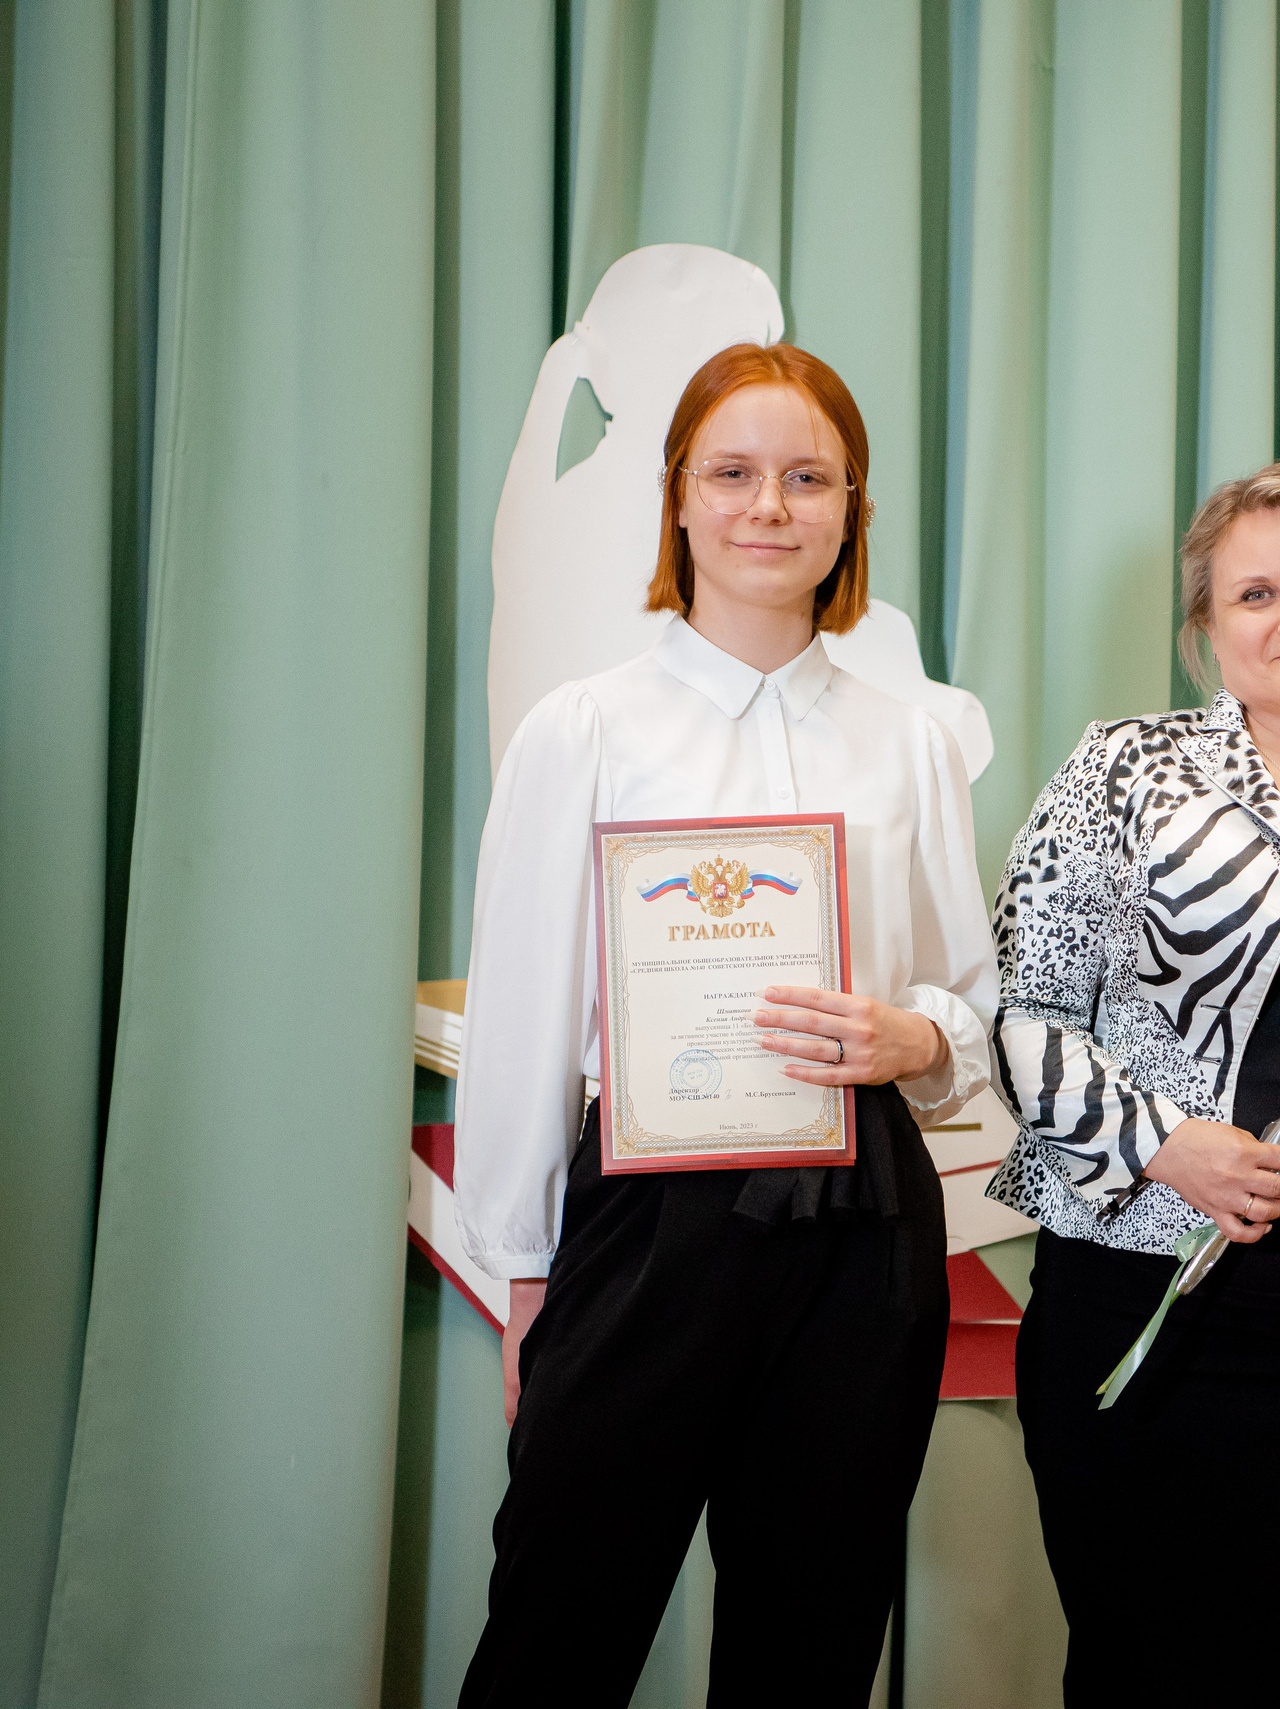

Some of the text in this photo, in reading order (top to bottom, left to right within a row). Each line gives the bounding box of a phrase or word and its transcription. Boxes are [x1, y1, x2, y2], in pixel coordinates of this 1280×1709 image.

[668, 921, 776, 942] ГРАМОТА
[631, 958, 691, 967] МУНИЦИПАЛЬНОЕ
[692, 955, 774, 964] ОБЩЕОБРАЗОВАТЕЛЬНОЕ
[707, 961, 751, 970] СОВЕТСКОГО
[752, 960, 779, 968] РАЙОНА
[703, 991, 756, 1000] НАГРАЖДАЕТС
